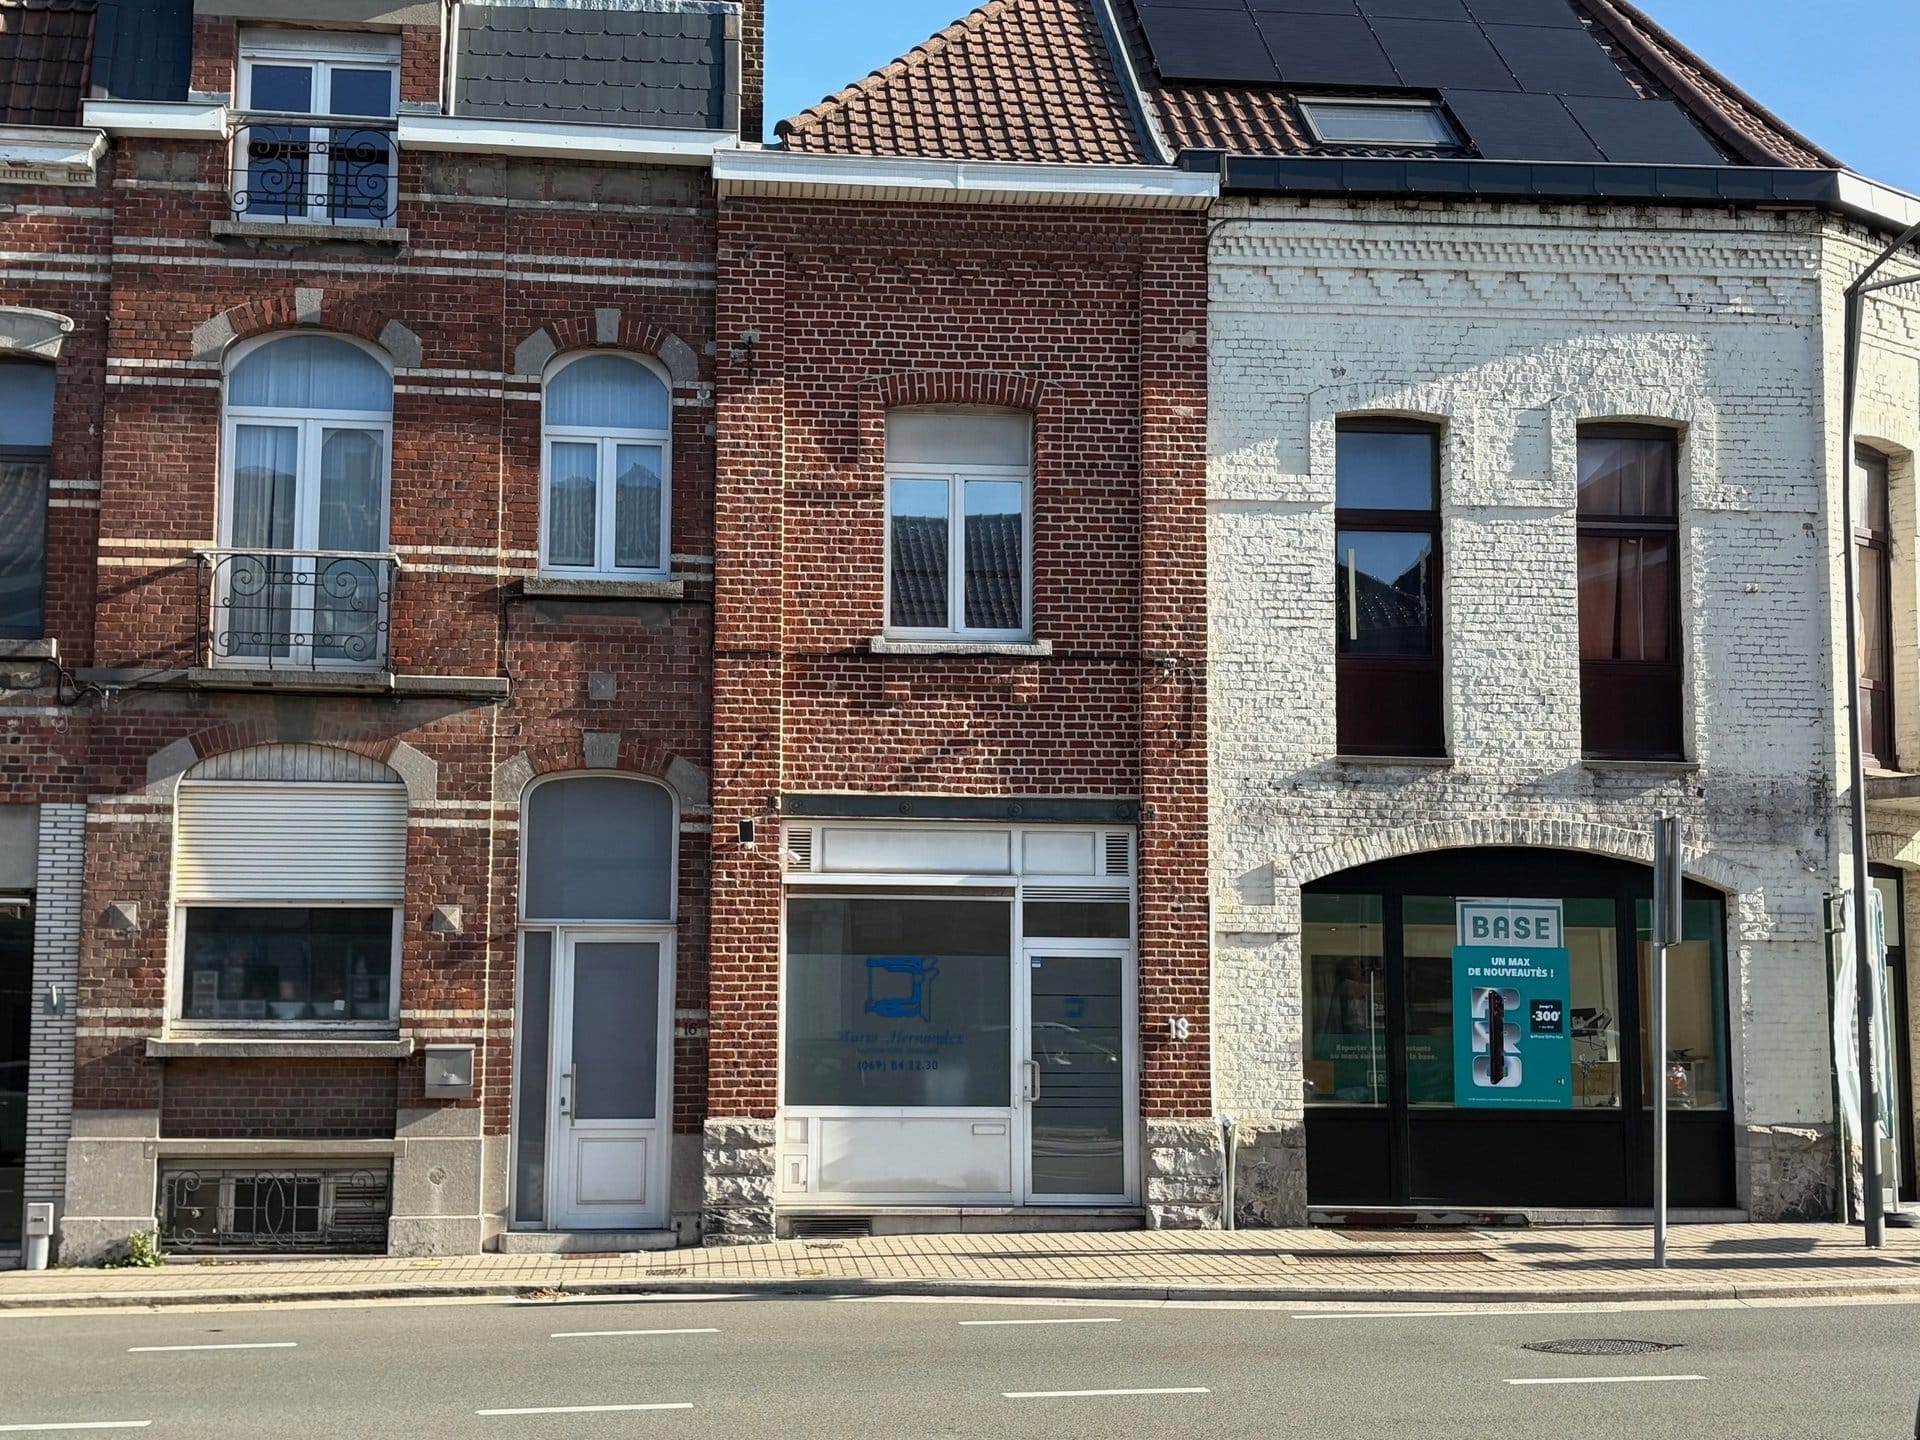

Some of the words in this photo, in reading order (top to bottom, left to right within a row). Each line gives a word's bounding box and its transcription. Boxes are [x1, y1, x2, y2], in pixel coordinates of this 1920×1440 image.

[1472, 915, 1550, 940] BASE
[1491, 957, 1506, 966] UN
[1508, 957, 1530, 966] MAX
[1468, 967, 1481, 976] DE
[684, 1022, 697, 1036] 16
[1168, 1017, 1189, 1040] 18
